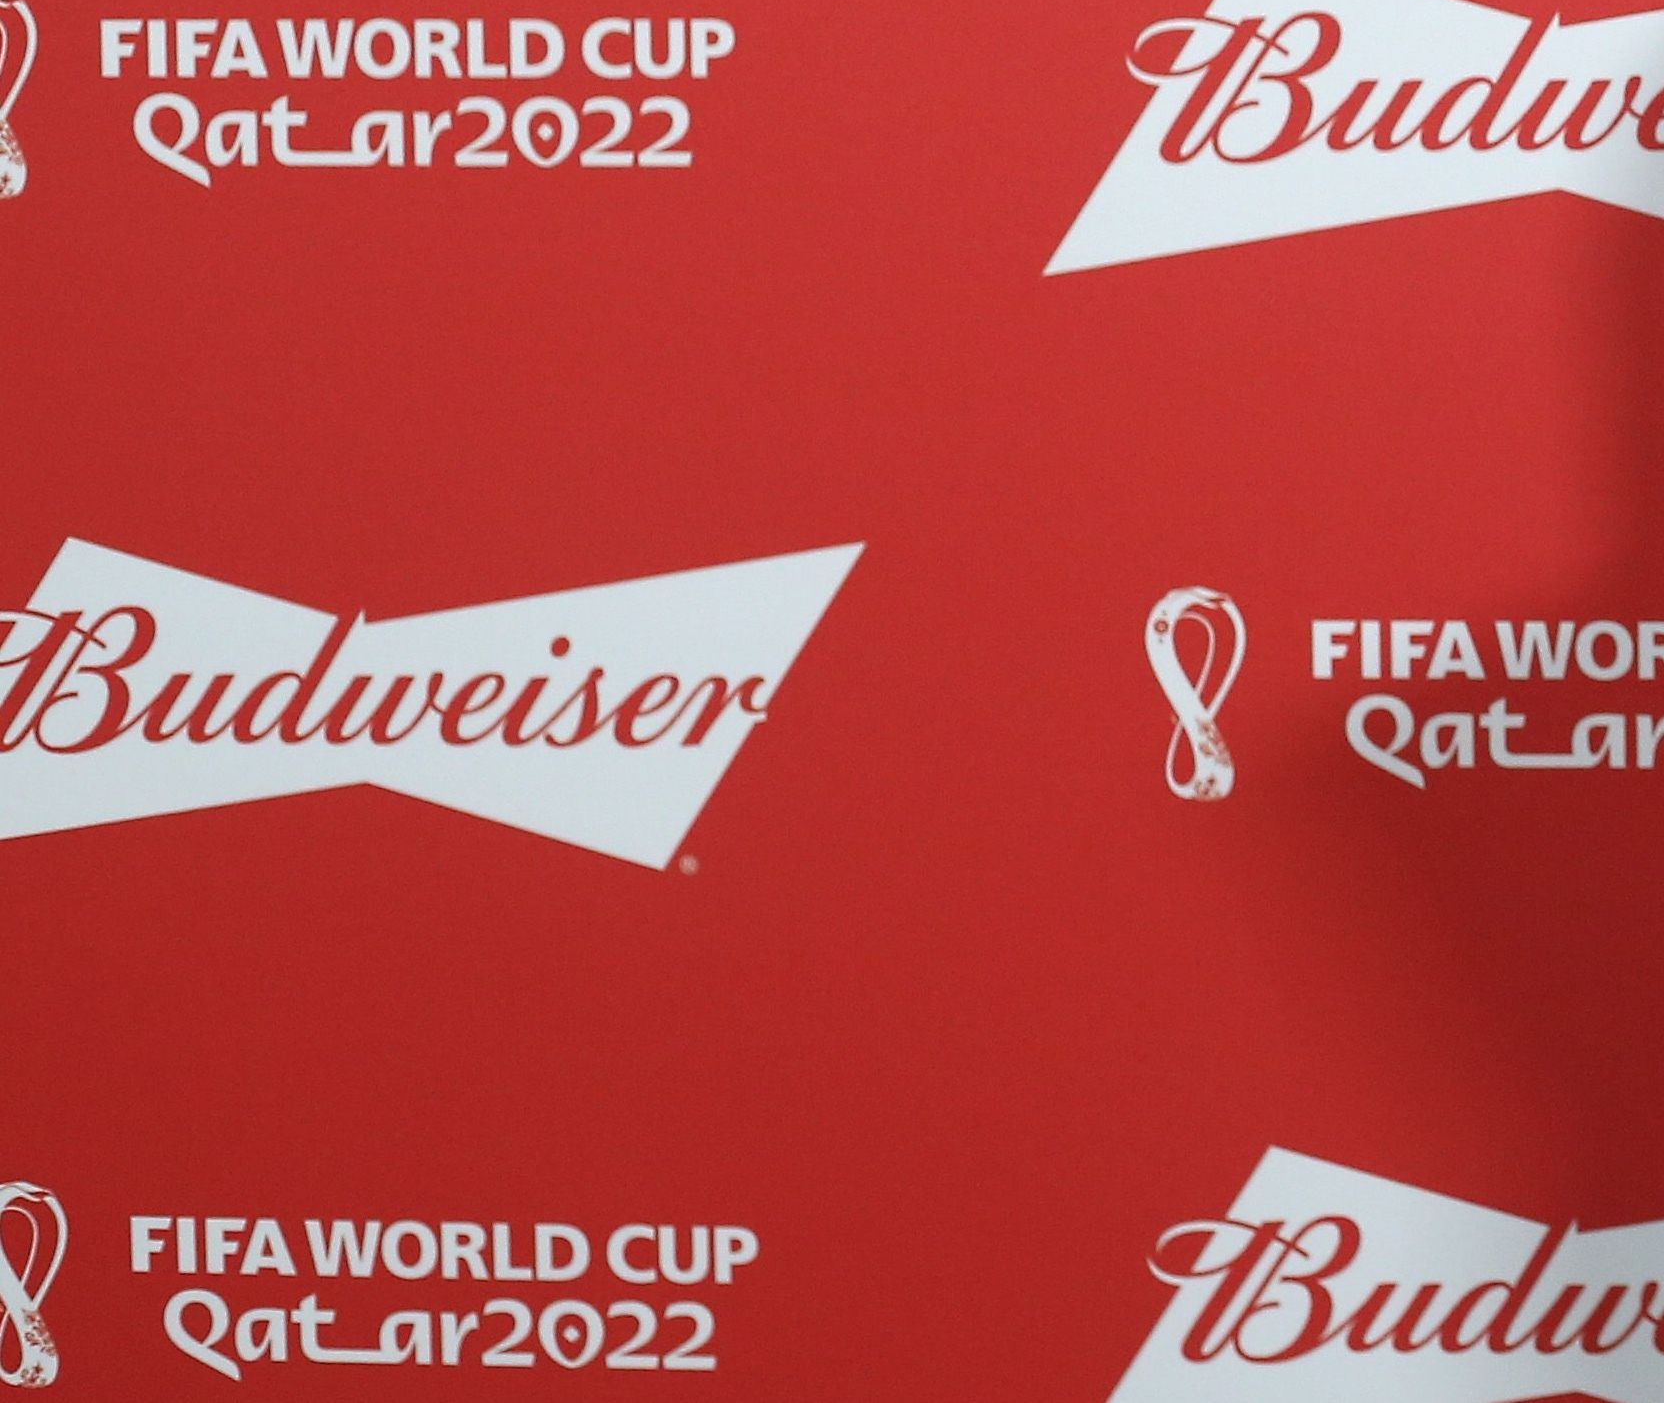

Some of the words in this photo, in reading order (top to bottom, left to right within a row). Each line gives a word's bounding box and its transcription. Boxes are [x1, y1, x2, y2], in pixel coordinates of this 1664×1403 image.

[101, 18, 267, 79] FIFA
[277, 18, 565, 79] WORLD
[582, 18, 736, 79] CUP
[134, 93, 693, 186] Qatar2022
[0, 605, 768, 755] Budweiser
[1312, 620, 1484, 680] FIFA
[131, 1216, 296, 1276] FIFA
[305, 1219, 590, 1281] WORLD
[607, 1224, 759, 1284] CUP
[164, 1289, 716, 1381] Qatar2022
